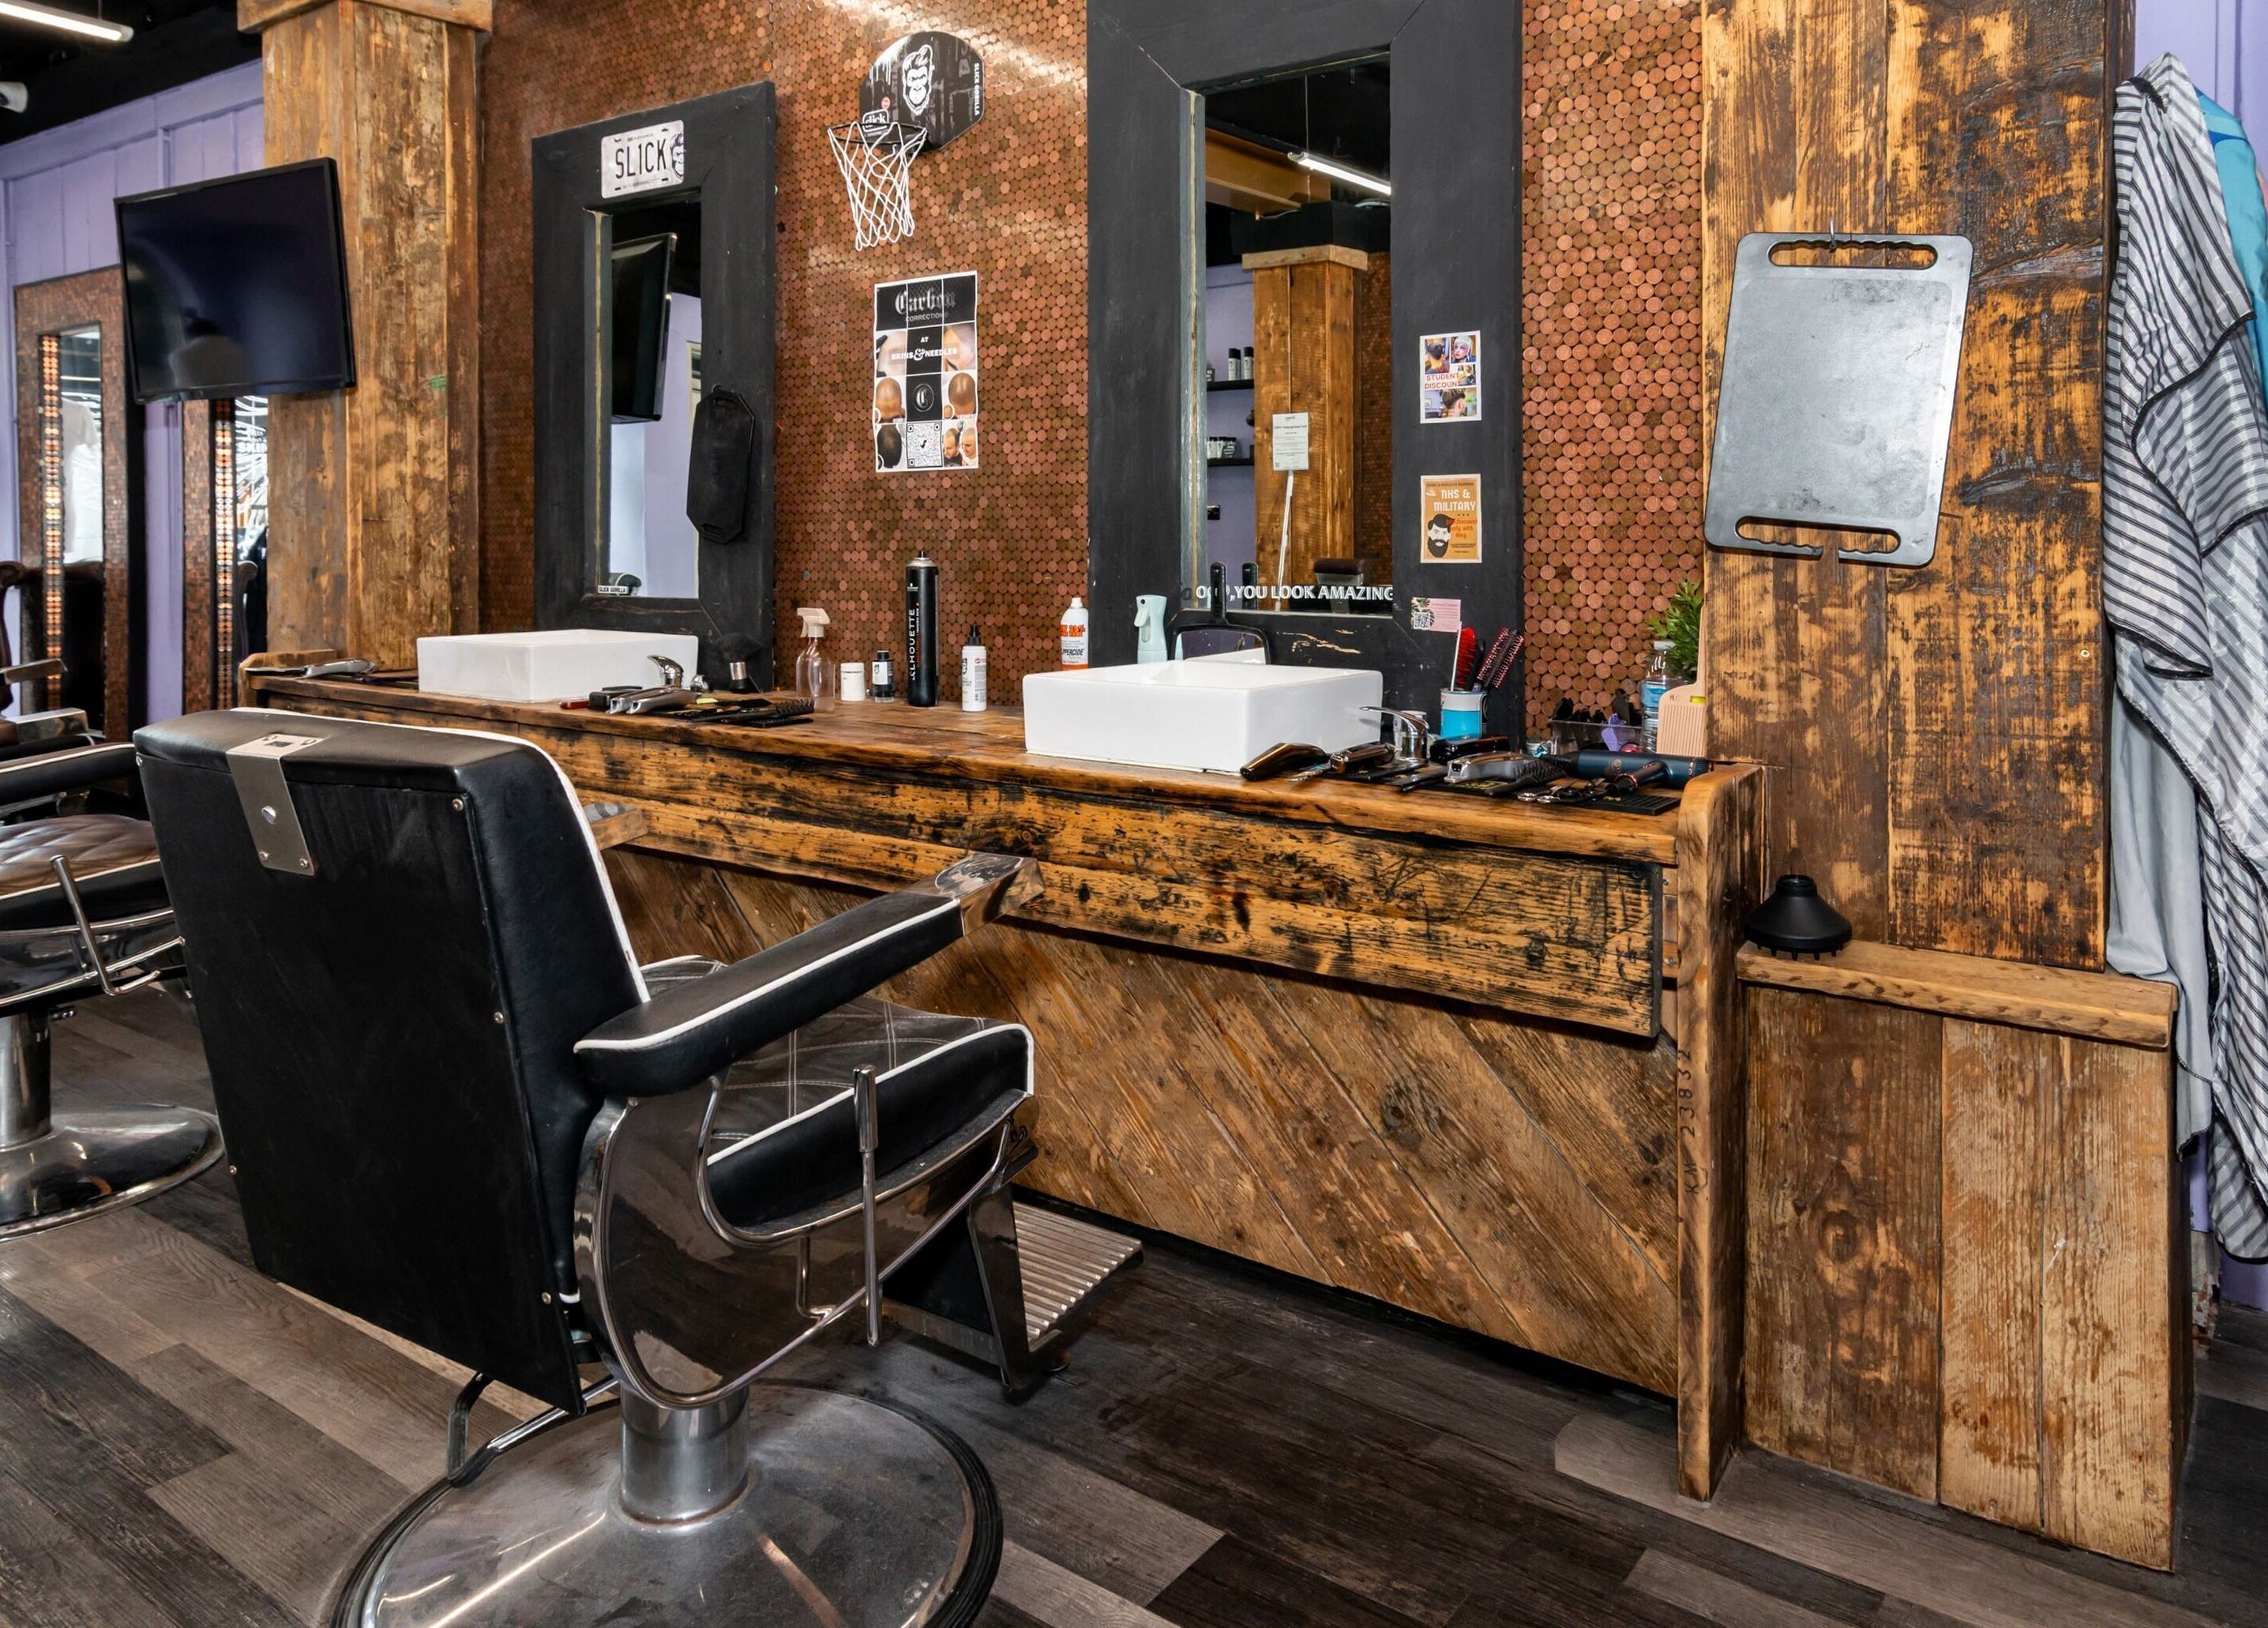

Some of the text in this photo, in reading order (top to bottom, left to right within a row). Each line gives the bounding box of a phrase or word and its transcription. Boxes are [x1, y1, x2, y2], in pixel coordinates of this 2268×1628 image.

[1441, 489, 1470, 499] NHS &
[1433, 501, 1476, 512] MILITARY
[1271, 585, 1316, 600] LOOK
